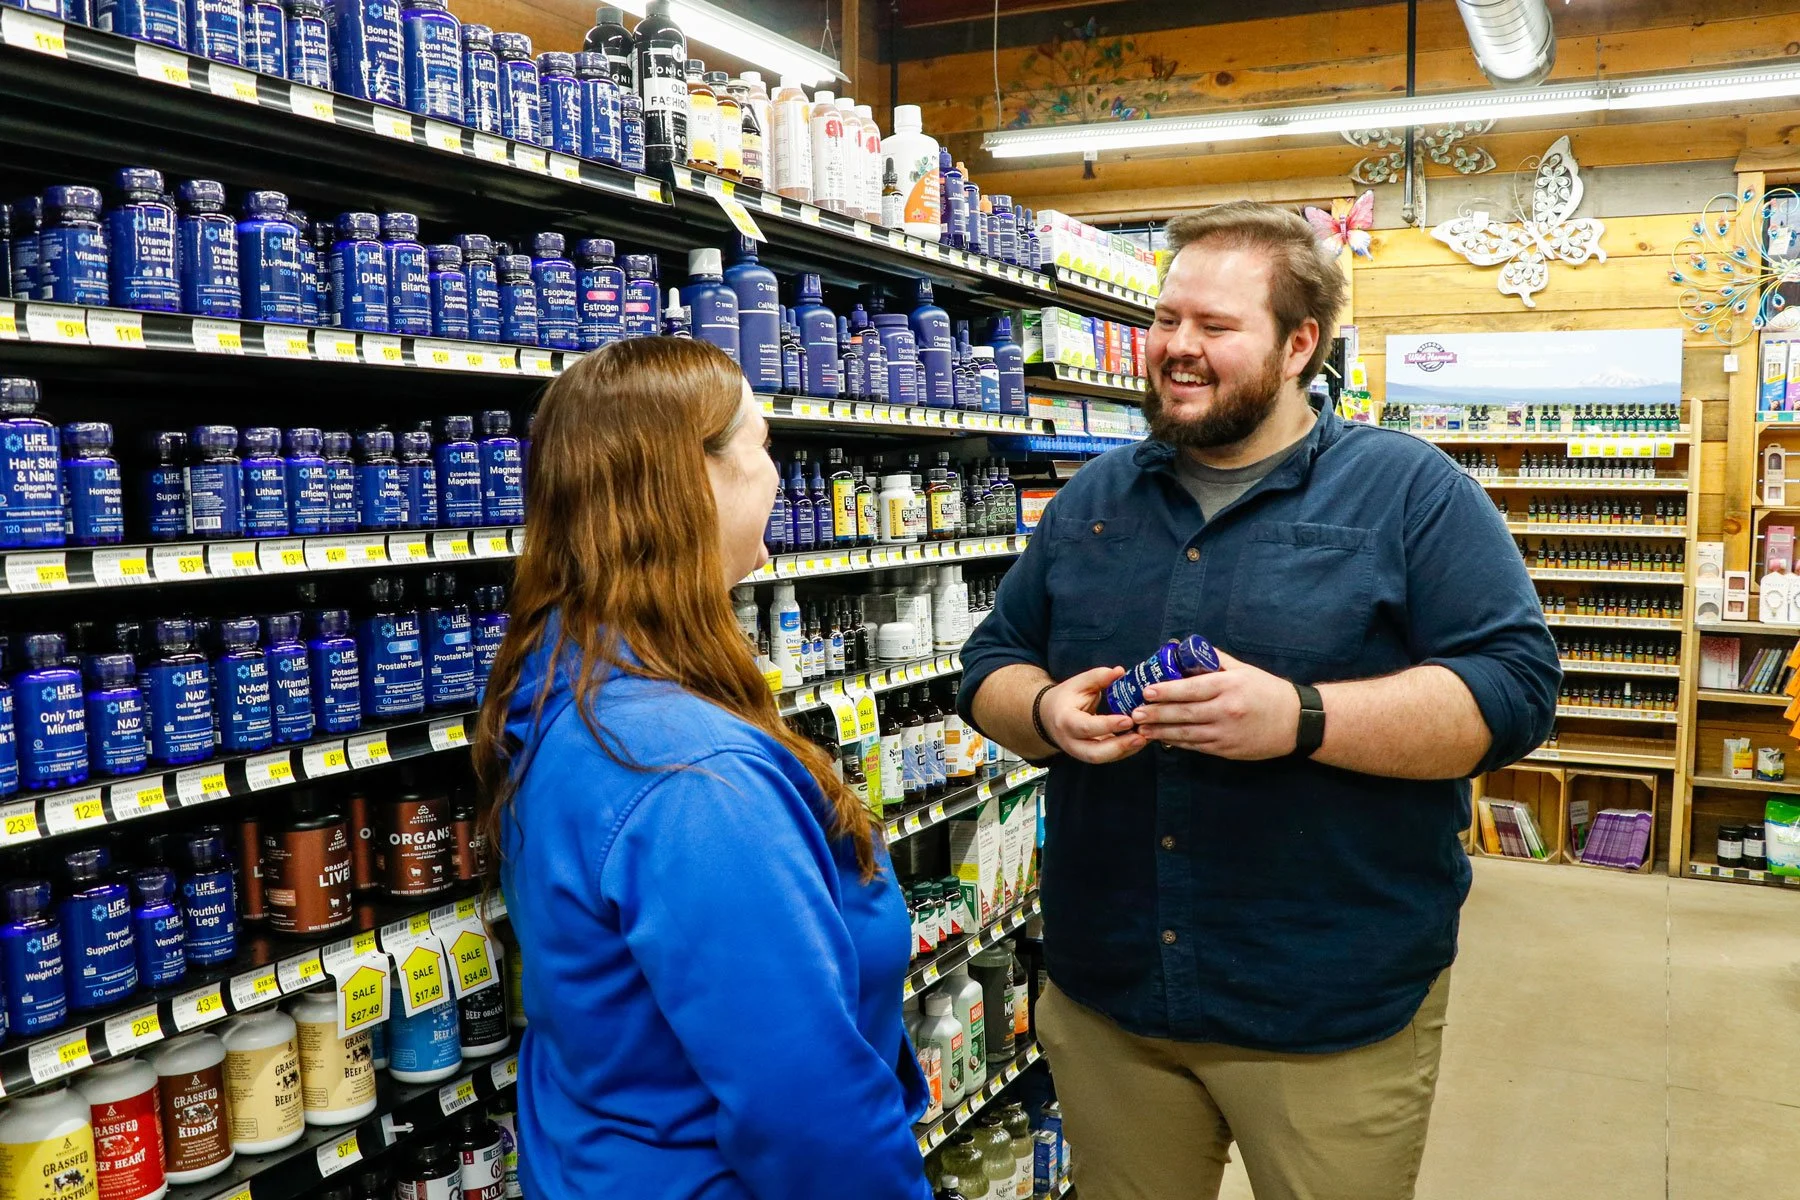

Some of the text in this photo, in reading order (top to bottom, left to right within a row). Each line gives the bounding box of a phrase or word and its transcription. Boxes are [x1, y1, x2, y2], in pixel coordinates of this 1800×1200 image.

[436, 27, 454, 37] LIFE
[648, 66, 682, 77] TONIC
[671, 83, 686, 96] OLD
[148, 217, 167, 228] LIFE
[142, 245, 165, 255] D and
[369, 251, 383, 261] LIFE
[361, 272, 387, 285] DHEA
[556, 271, 570, 279] LIFE
[593, 276, 610, 284] LIFE
[263, 304, 276, 312] 100
[583, 302, 619, 314] Estrogen
[24, 433, 47, 445] LIFE
[25, 445, 58, 453] EXTENSION
[504, 450, 517, 458] LIFE
[460, 451, 475, 459] LIFE
[9, 458, 57, 472] Hair, Skin
[17, 470, 55, 482] & Nails
[105, 468, 118, 477] LIFE
[262, 469, 277, 477] LIFE
[336, 468, 349, 476] LIFE
[503, 476, 519, 485] Caps
[14, 483, 45, 494] Collagen
[255, 488, 282, 496] Lithium
[330, 483, 353, 492] Healthy
[24, 491, 52, 500] Formula
[156, 492, 181, 502] Super
[333, 491, 352, 500] Lungs
[4, 525, 20, 534] 120
[41, 571, 65, 579] $27.59
[451, 615, 467, 624] LIFE
[395, 621, 413, 631] LIFE
[341, 650, 355, 660] LIFE
[434, 652, 462, 661] Prostate
[250, 663, 264, 672] LIFE
[292, 658, 306, 666] LIFE
[377, 661, 407, 671] Prostate
[186, 670, 203, 680] LIFE
[1152, 662, 1164, 679] LIFE
[57, 684, 76, 695] LIFE
[277, 678, 307, 690] Vitamin
[119, 700, 135, 708] LIFE
[40, 711, 66, 724] Only
[860, 708, 872, 717] SALE
[842, 715, 852, 723] SALE
[47, 721, 84, 735] Minerals
[860, 721, 875, 732] $37.99
[239, 735, 248, 743] 60
[169, 744, 179, 752] 30
[38, 765, 48, 774] 90
[270, 766, 289, 776] $13.39
[203, 776, 223, 789] $54.99
[141, 793, 162, 804] $49.99
[409, 817, 437, 825] NUTRITION
[412, 813, 435, 821] ANCIENT
[389, 826, 450, 846] ORGANS
[414, 843, 437, 851] BLEND
[195, 881, 216, 892] LIFE
[196, 887, 226, 897] EXTENSION
[108, 898, 126, 912] LIFE
[187, 903, 226, 917] Youthful
[166, 916, 179, 927] LIFE
[196, 916, 220, 927] Legs
[106, 926, 129, 940] Thyroid
[41, 932, 58, 946] LIFE
[86, 939, 119, 957] Support
[460, 948, 481, 964] SALE
[25, 967, 52, 982] Weight
[413, 965, 434, 981] SALE
[464, 969, 488, 985] $34.49
[93, 986, 124, 997] 60 CAPSULES
[352, 984, 376, 1001] SALE
[415, 984, 440, 1002] $17.49
[350, 1004, 379, 1023] $27.49
[465, 1009, 482, 1021] BEEF
[27, 1016, 37, 1026] 60
[434, 1028, 449, 1041] BEEF
[63, 1044, 86, 1059] $16.69
[344, 1066, 363, 1079] BEEF
[174, 1088, 218, 1109] GRASSFED
[275, 1094, 292, 1107] BEEF
[178, 1122, 218, 1140] KIDNEY
[43, 1150, 89, 1178] GRASSFED
[115, 1147, 146, 1170] HEART
